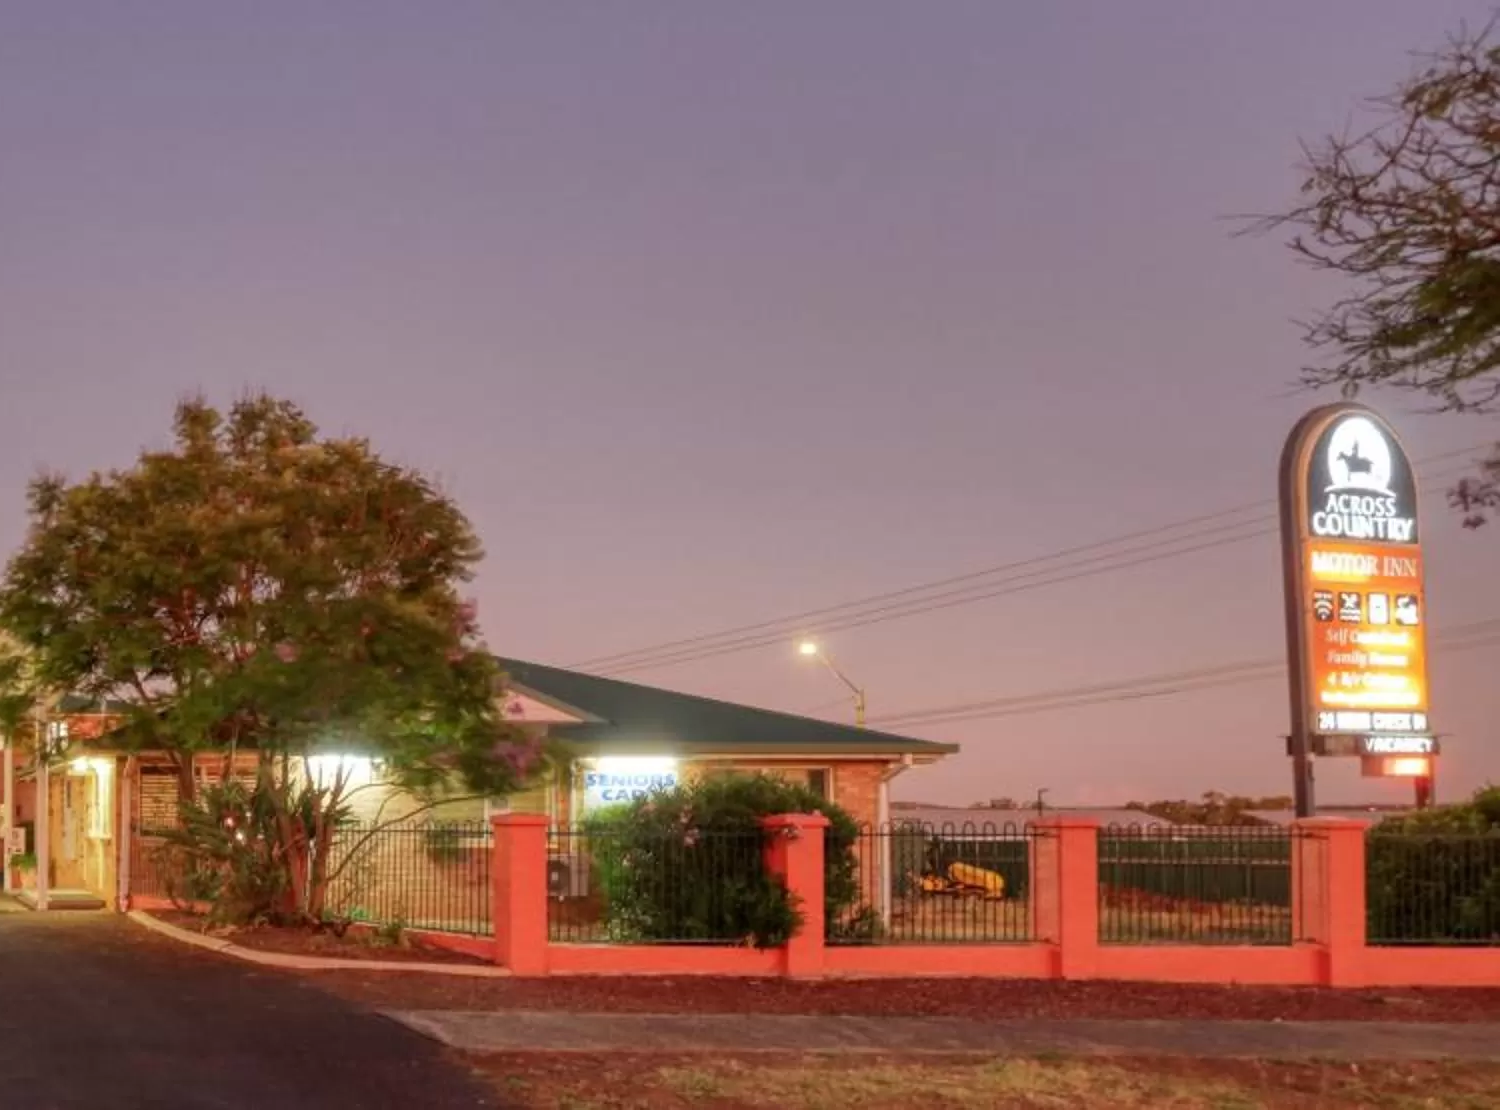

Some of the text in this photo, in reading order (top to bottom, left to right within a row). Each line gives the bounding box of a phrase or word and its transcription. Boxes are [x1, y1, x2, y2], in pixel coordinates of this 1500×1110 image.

[1325, 493, 1397, 517] ACROSS
[1312, 511, 1414, 541] COUNTRY
[1312, 551, 1417, 577] MOTOR INN
[1318, 711, 1335, 730] 24
[587, 773, 675, 786] SENIORS
